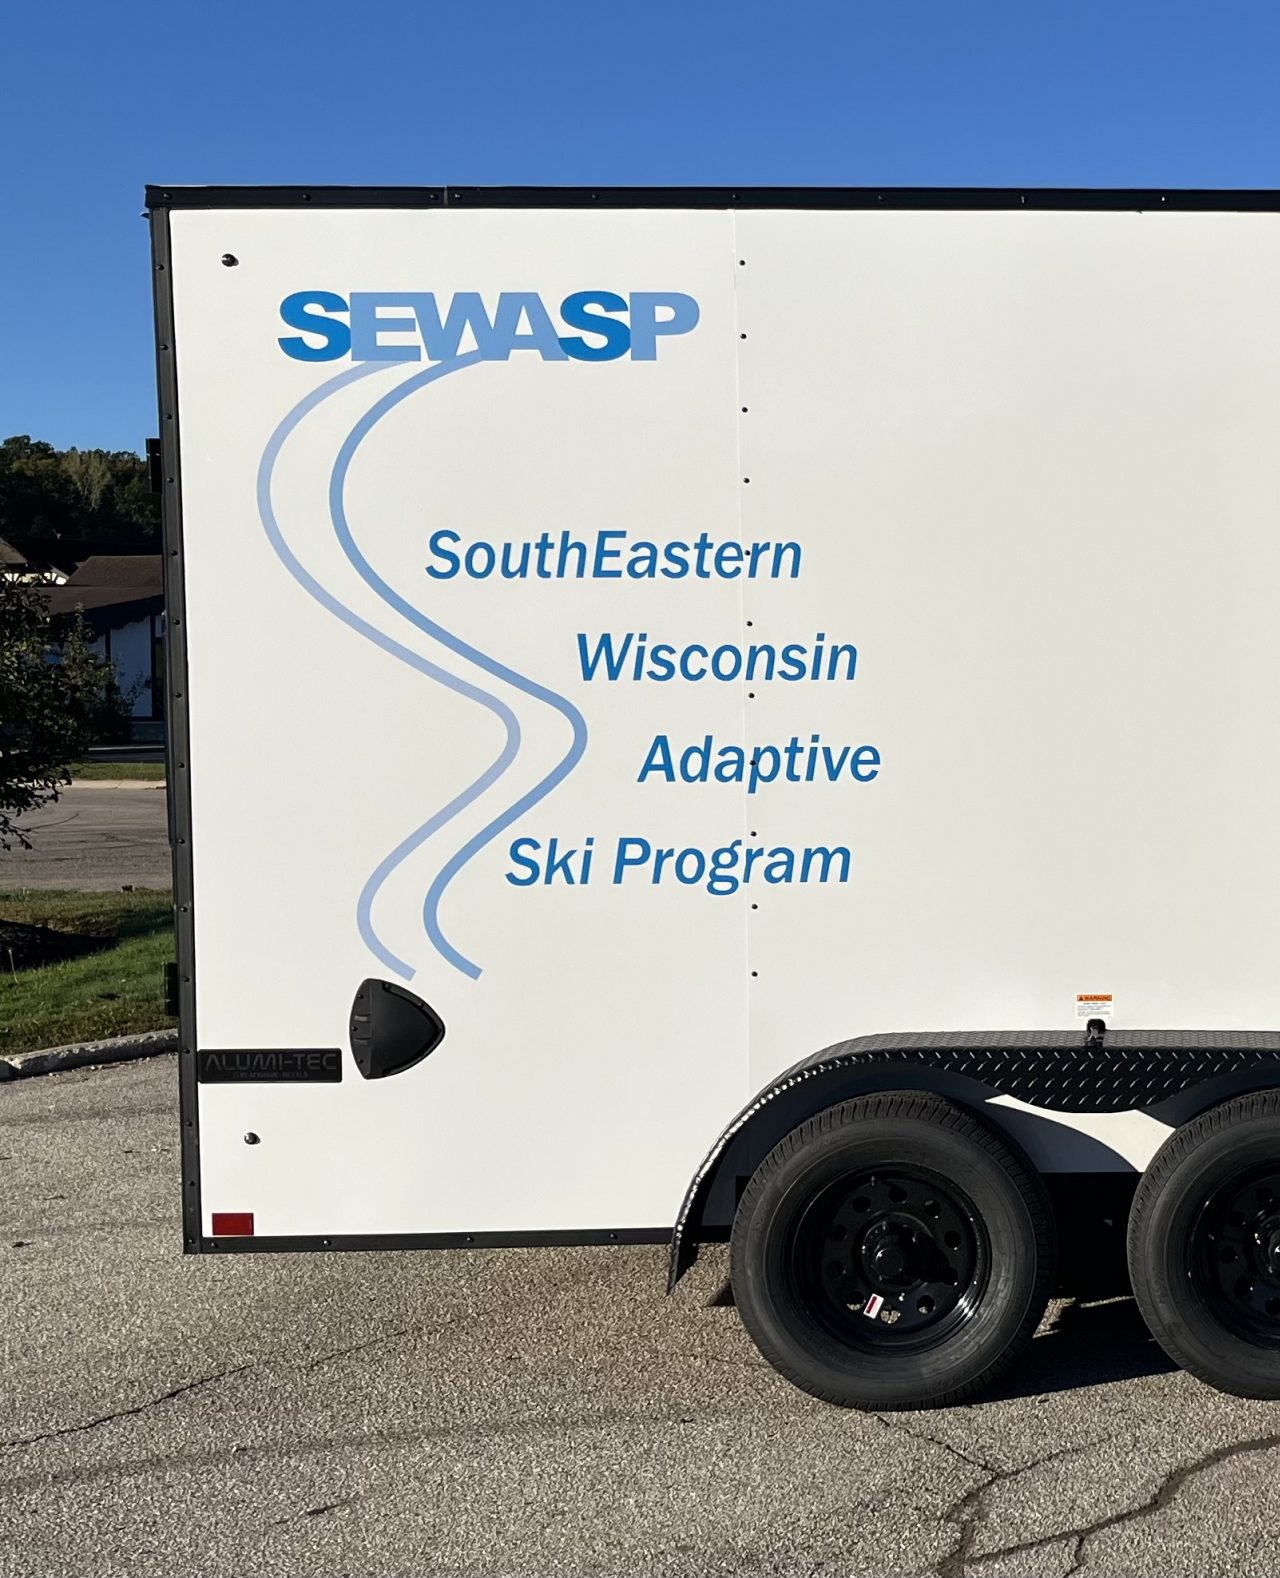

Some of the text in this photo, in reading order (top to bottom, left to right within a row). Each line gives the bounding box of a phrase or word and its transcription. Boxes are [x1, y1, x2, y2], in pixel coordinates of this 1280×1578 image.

[278, 291, 700, 362] SEWASP
[425, 529, 802, 579] SouthEastern
[576, 632, 858, 682] Wisconsin
[636, 734, 881, 794] Adaptive
[505, 837, 852, 896] Ski Program
[205, 1054, 337, 1071] ALUMI-TEC
